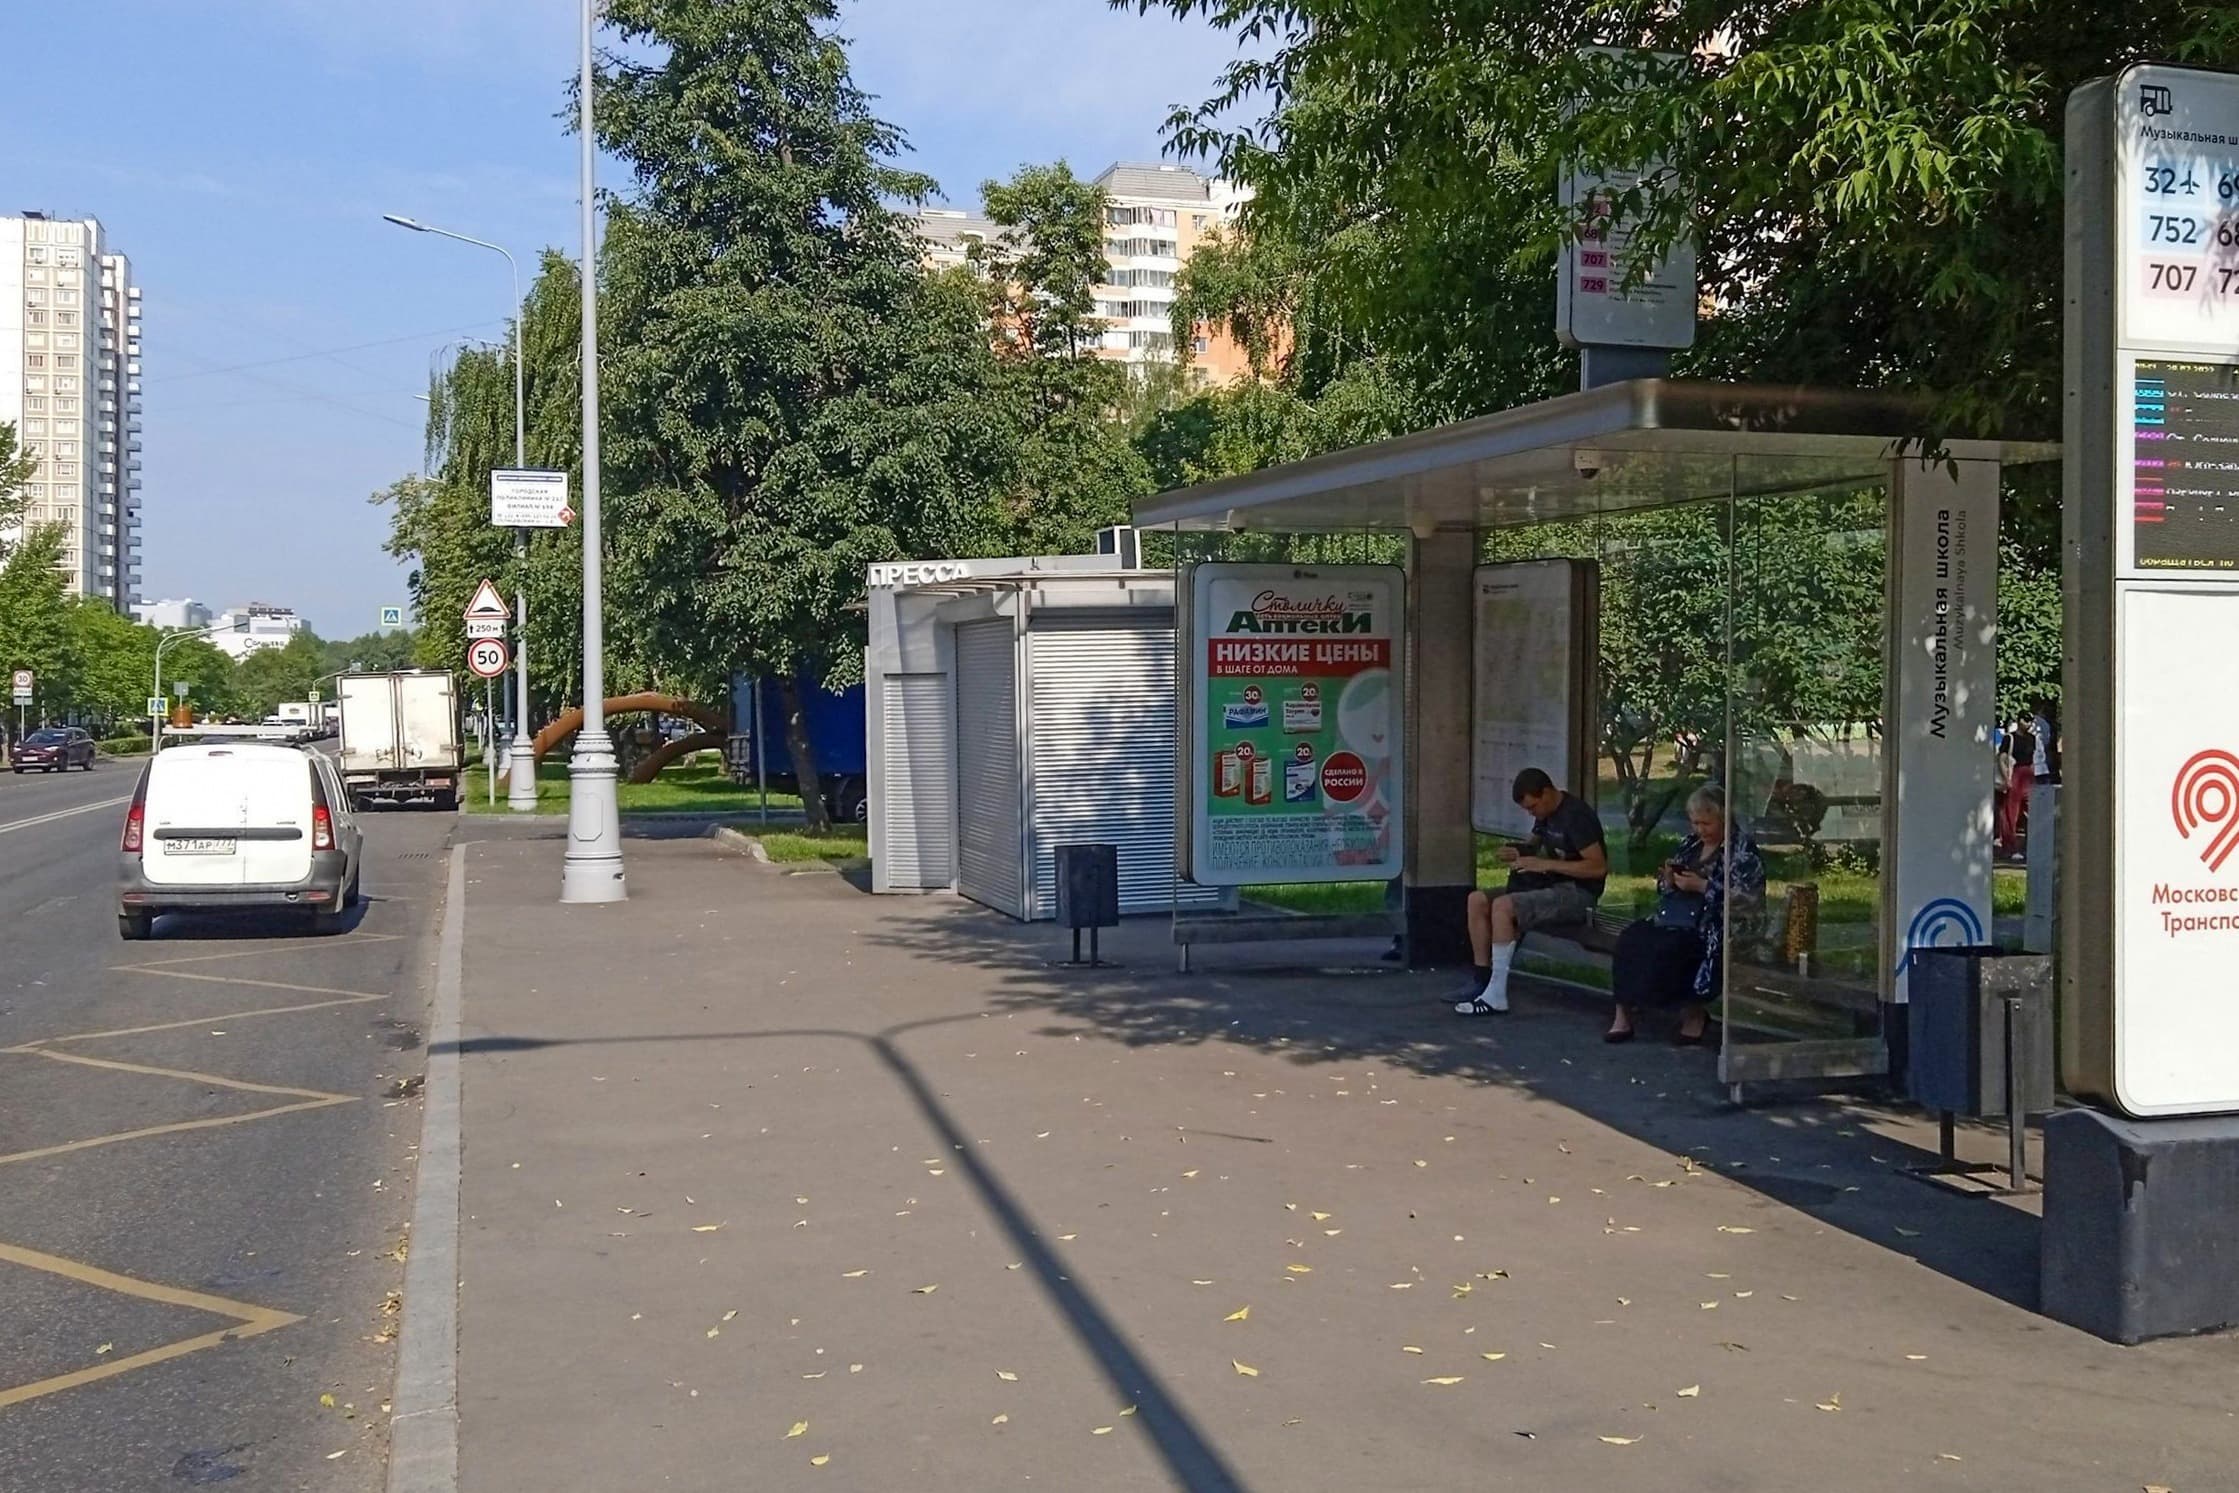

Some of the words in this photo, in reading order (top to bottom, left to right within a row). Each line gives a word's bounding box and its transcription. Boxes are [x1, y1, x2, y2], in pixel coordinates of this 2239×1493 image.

[2141, 125, 2226, 144] Музыкальная
[2145, 166, 2176, 194] 32
[2150, 215, 2197, 244] 752
[1583, 253, 1604, 265] 707
[1583, 279, 1604, 290] 729
[2150, 263, 2198, 291] 707
[1936, 509, 1950, 578] школа
[1954, 510, 1967, 557] Shkola
[870, 563, 968, 586] ПРЕССА
[1953, 560, 1967, 650] Muzykalnaya
[476, 624, 492, 632] 250
[477, 650, 499, 665] 50
[1216, 643, 1310, 662] НИЗКИЕ
[1316, 644, 1379, 664] ЦЕНЫ
[1931, 587, 1950, 739] Музыкальная
[1216, 665, 1223, 674] В
[1225, 665, 1251, 674] ШАГЕ
[1252, 665, 1265, 674] ОТ
[1266, 665, 1298, 675] ДОМА
[1324, 778, 1364, 787] РОССИИ
